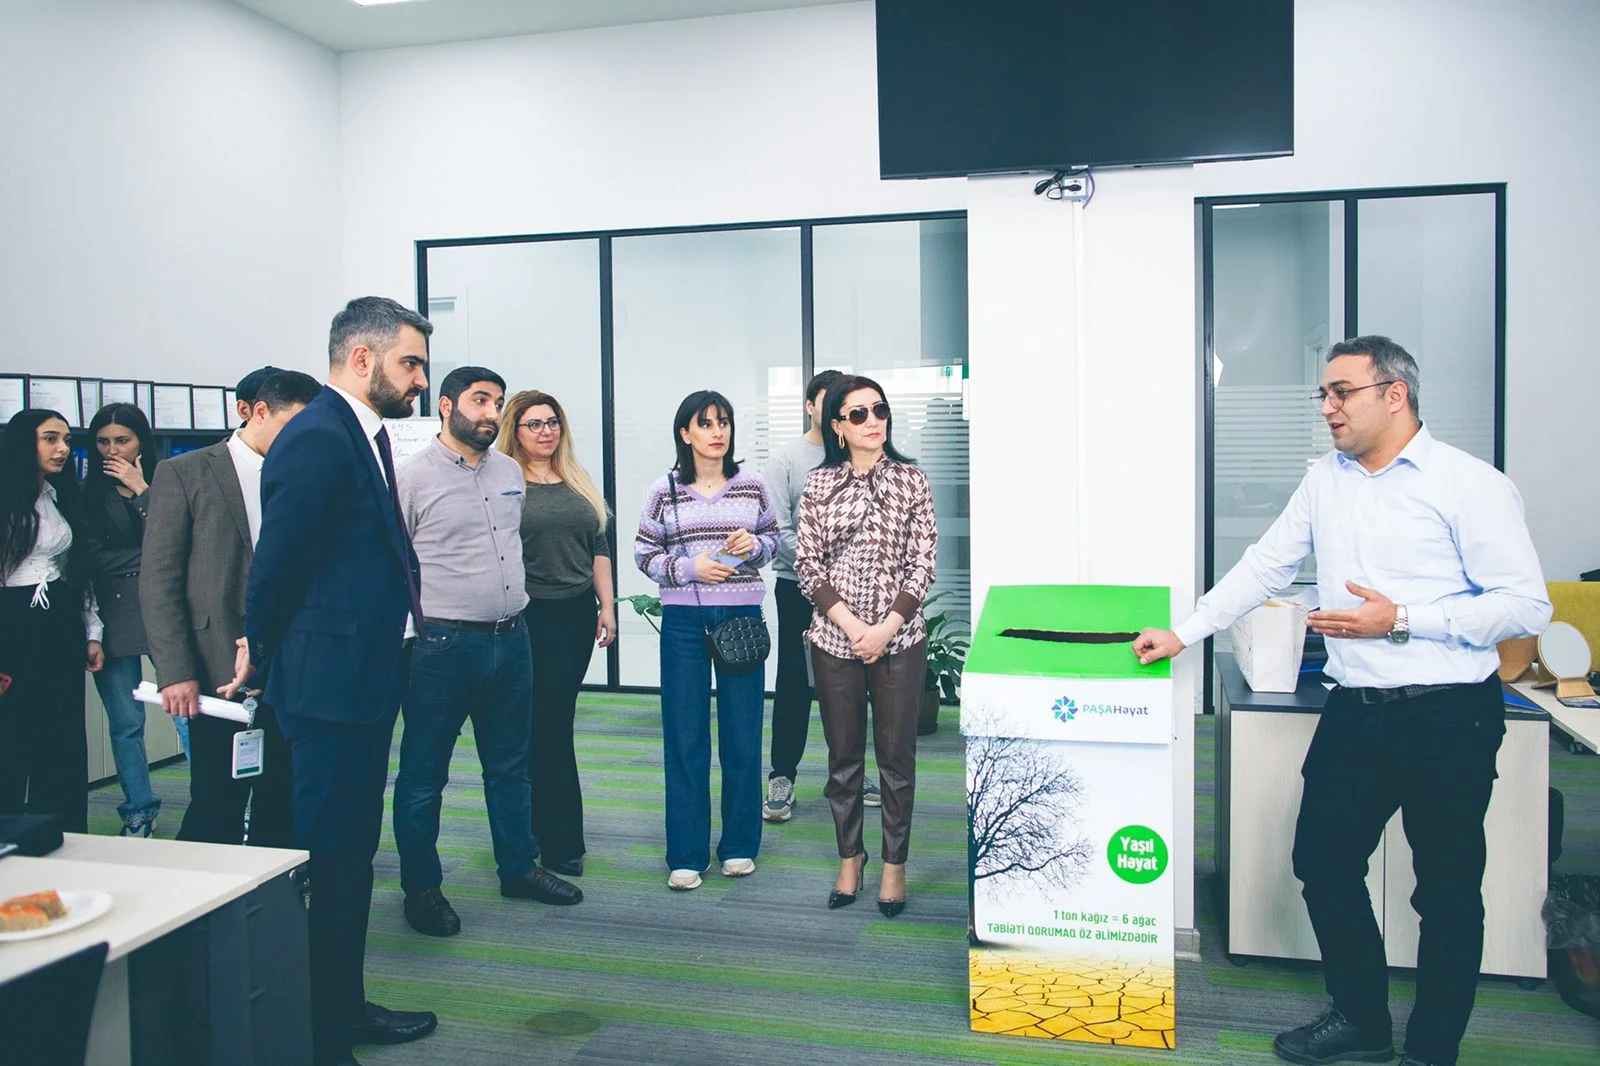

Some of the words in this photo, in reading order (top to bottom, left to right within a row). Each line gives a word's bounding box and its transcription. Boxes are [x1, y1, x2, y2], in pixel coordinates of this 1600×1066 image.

[1120, 836, 1154, 854] Yaşıl
[1117, 853, 1158, 872] Həyat
[1053, 909, 1059, 920] 1
[1061, 910, 1078, 921] ton
[1081, 911, 1109, 925] kağız
[1122, 913, 1129, 924] 6
[1028, 926, 1077, 938] QORUMAQ
[1079, 927, 1092, 940] ÖZ
[1095, 930, 1158, 944] ƏLİMİZDƏDİR
